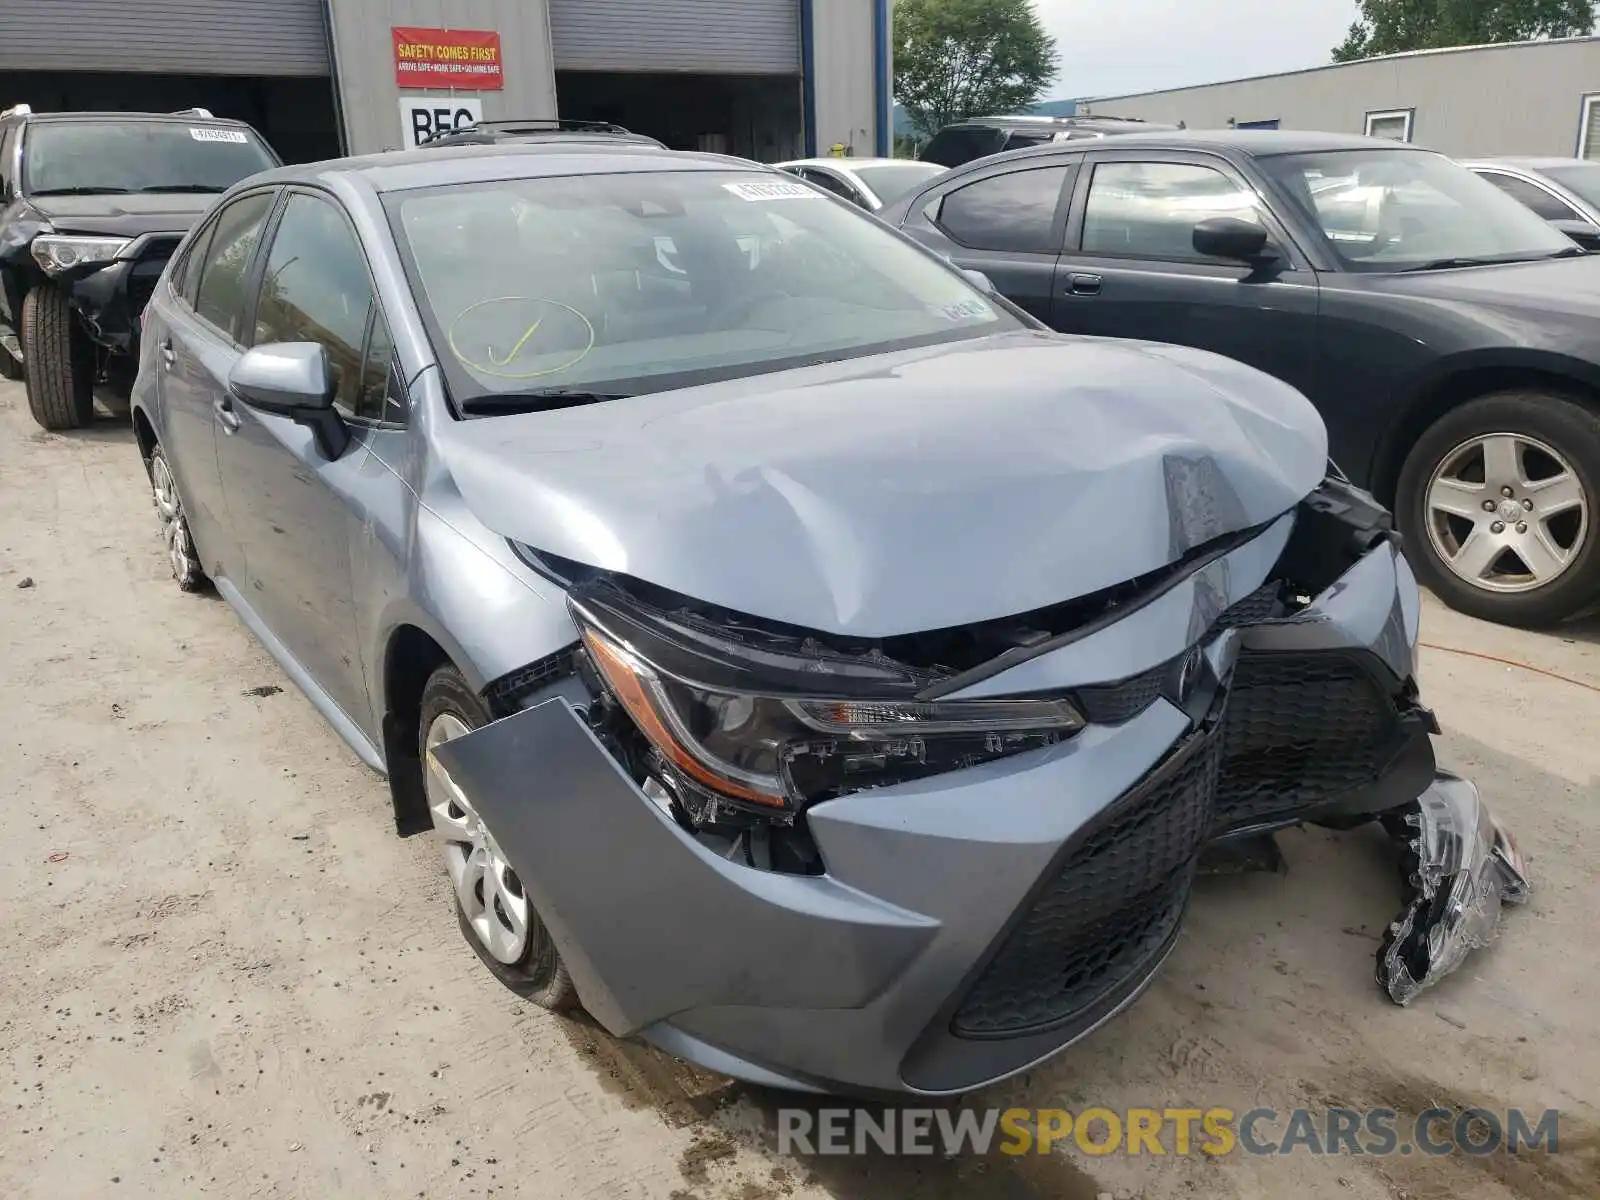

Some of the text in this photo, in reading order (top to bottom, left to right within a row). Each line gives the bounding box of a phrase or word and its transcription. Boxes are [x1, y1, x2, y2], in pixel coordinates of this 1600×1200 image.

[398, 43, 496, 61] SAFETY COMES FIRST
[398, 62, 501, 74] ARRIVE SAFE WORK SAFE GO HOME SAFE
